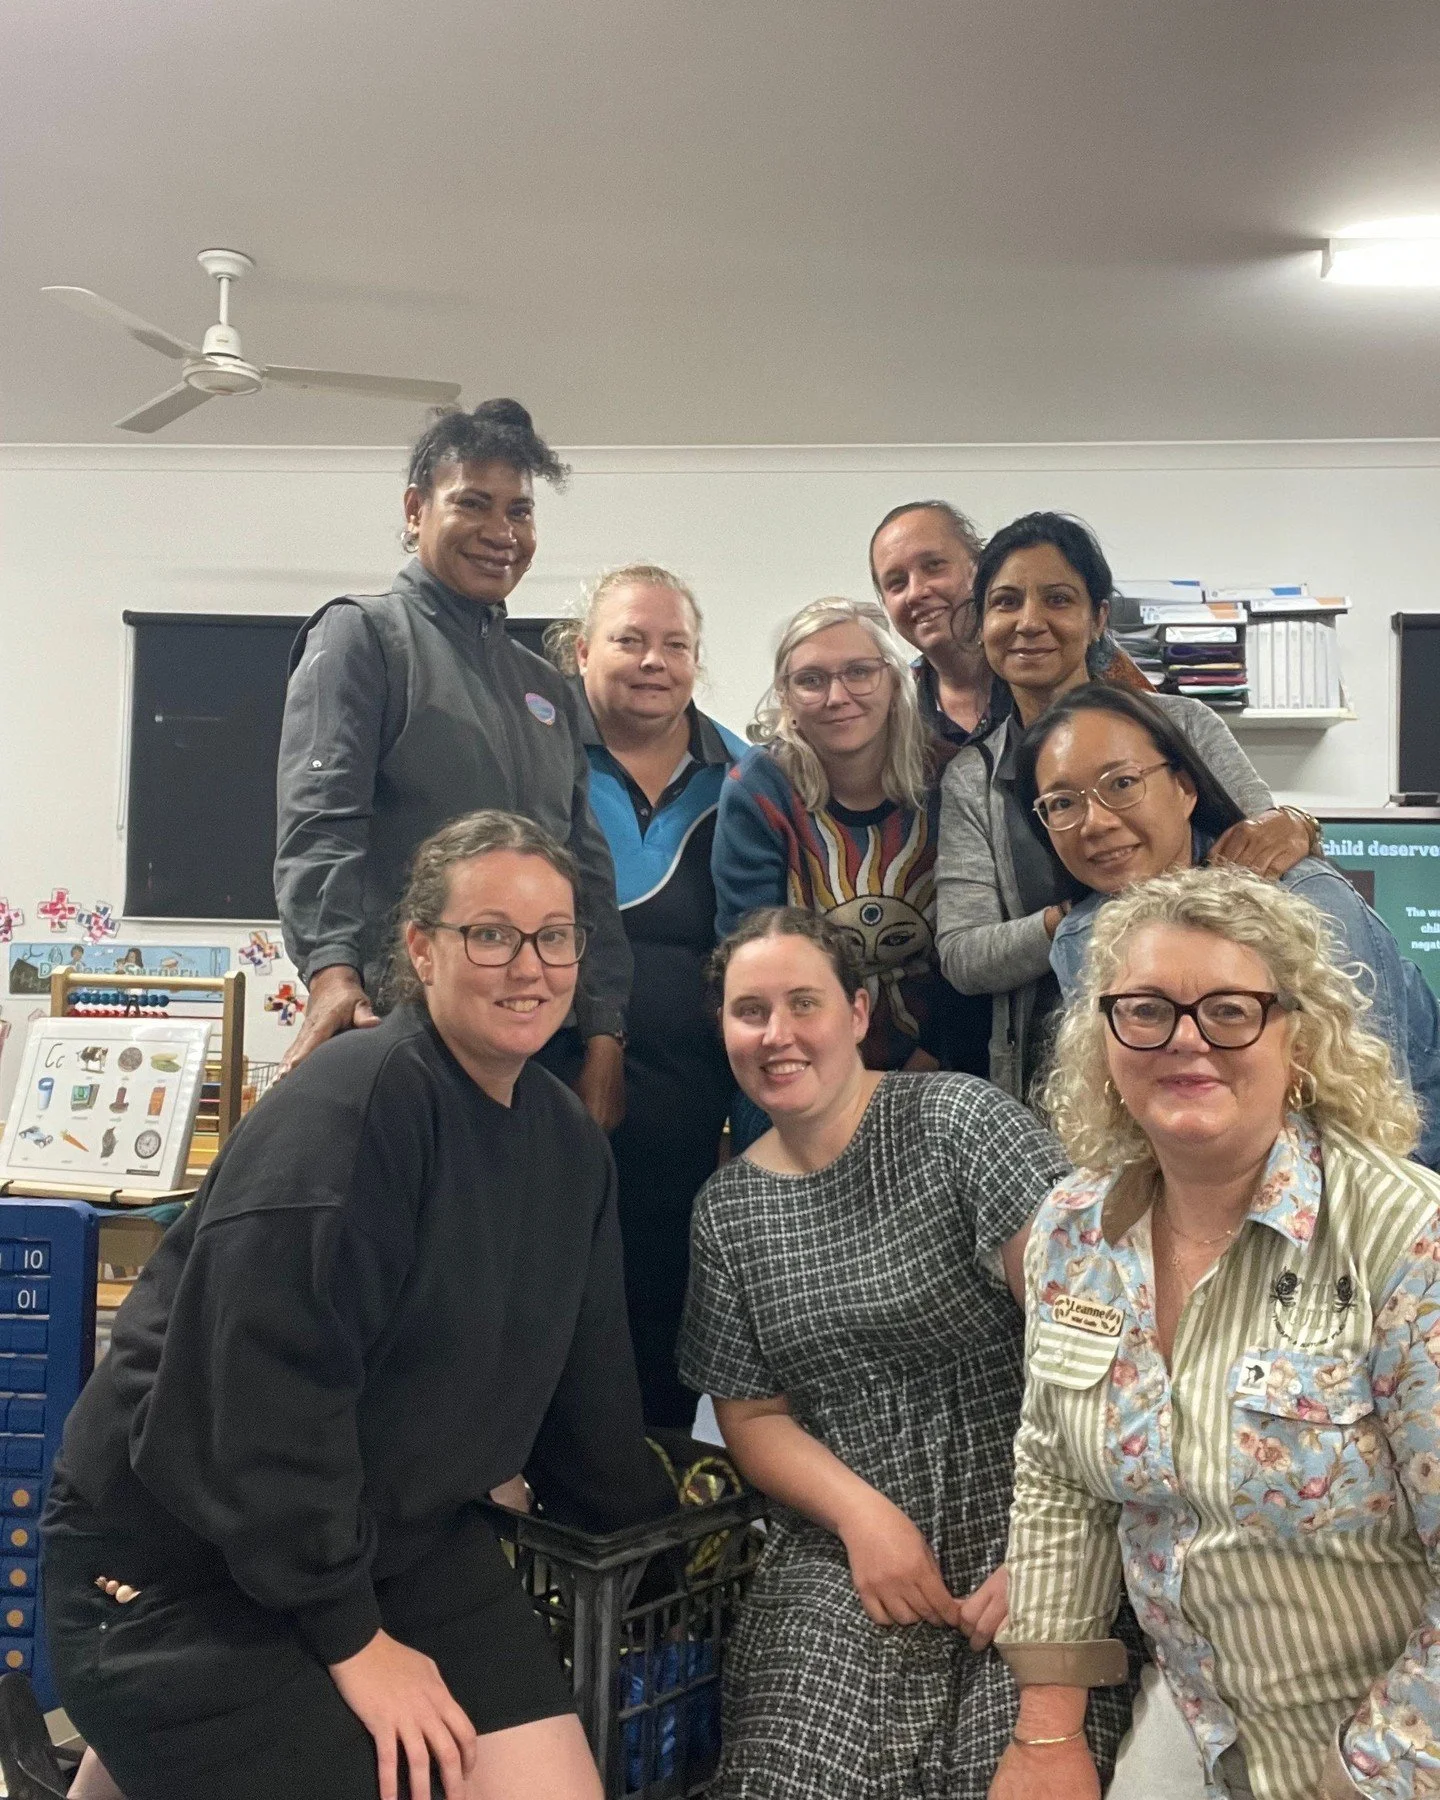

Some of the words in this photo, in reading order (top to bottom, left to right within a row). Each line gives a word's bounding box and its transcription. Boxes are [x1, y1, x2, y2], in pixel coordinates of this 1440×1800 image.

[1322, 840, 1363, 856] child
[1368, 840, 1440, 857] deserve
[1405, 906, 1426, 917] The
[45, 1043, 65, 1069] Cc
[24, 1249, 43, 1269] 10
[1069, 1300, 1106, 1318] Leanne
